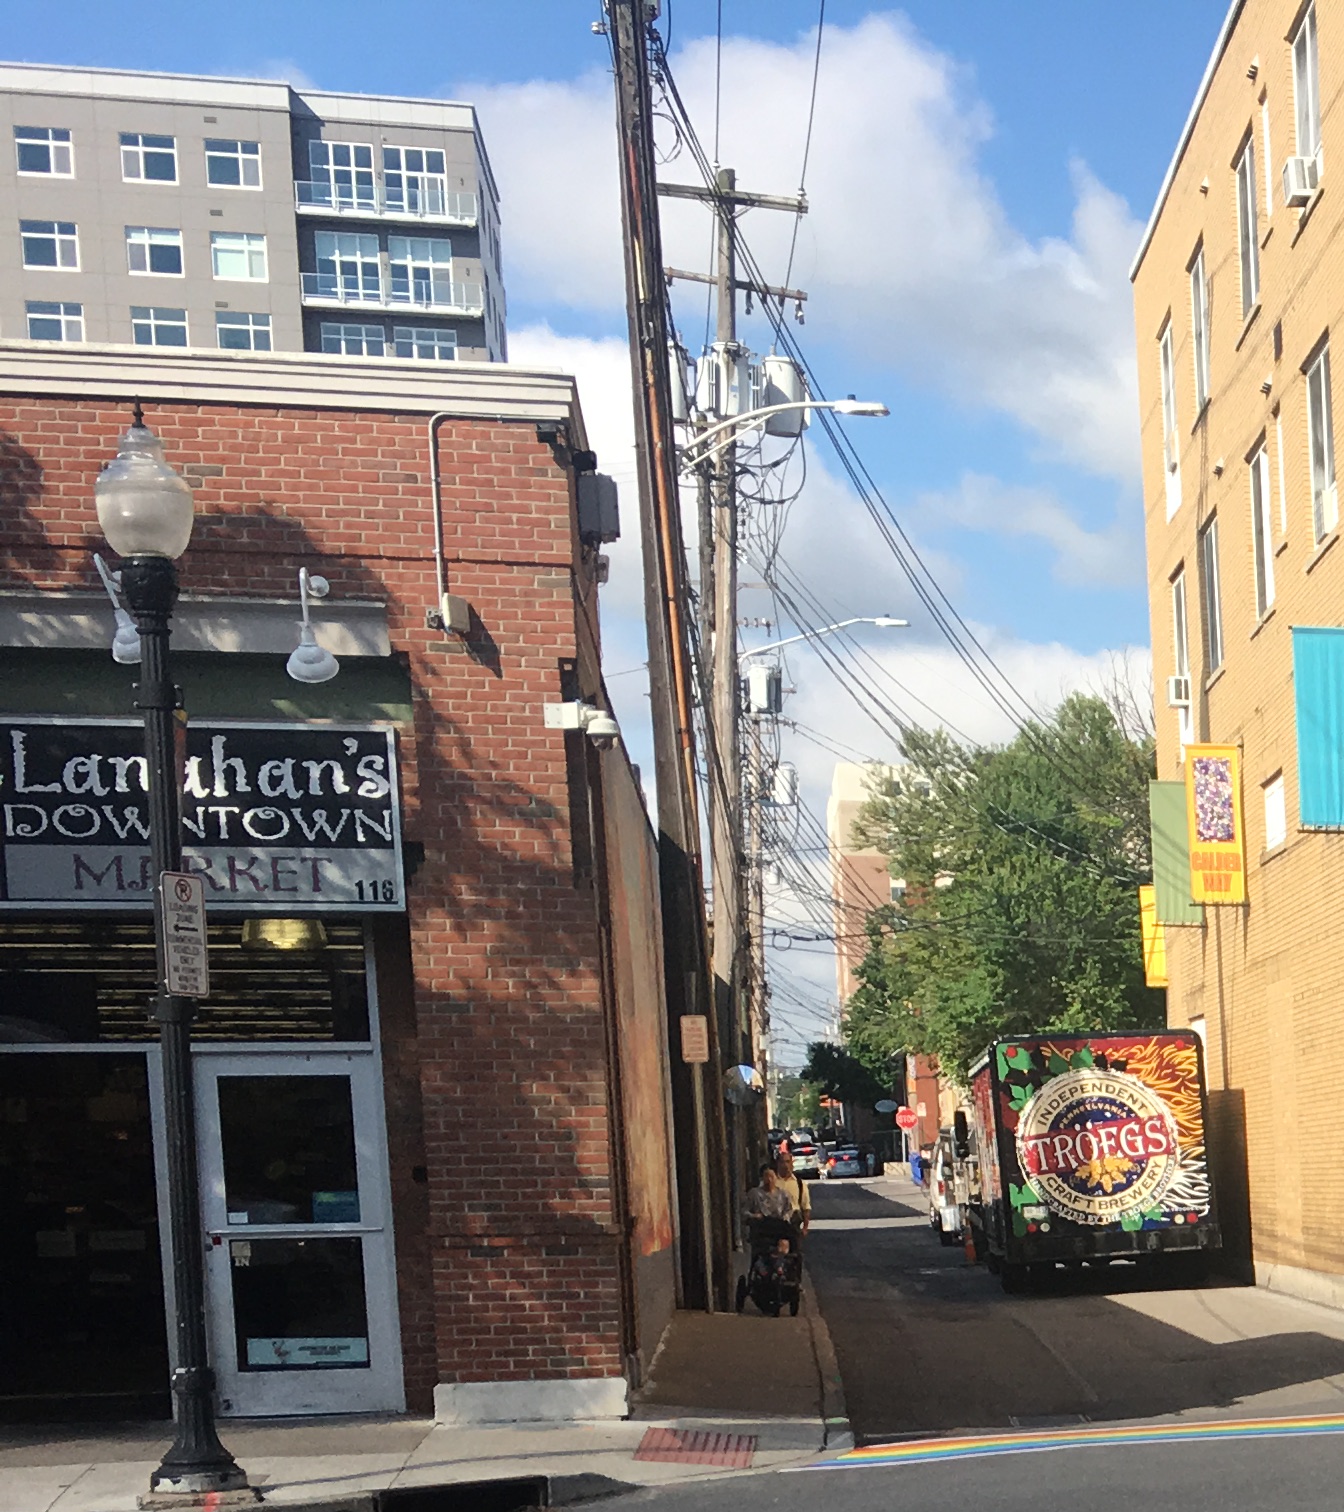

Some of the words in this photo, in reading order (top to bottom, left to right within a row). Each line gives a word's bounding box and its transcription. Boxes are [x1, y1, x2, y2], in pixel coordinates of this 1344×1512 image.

[4, 803, 392, 842] DOWNTOWN
[1192, 851, 1241, 872] CALDER
[355, 879, 395, 902] 116
[1202, 872, 1232, 892] WAY
[1037, 1083, 1149, 1127] INDEPENDENT
[1059, 1101, 1128, 1129] PENNSYLVANIA
[899, 1114, 917, 1124] STOP
[1045, 1176, 1095, 1209] CRAFT
[1098, 1159, 1162, 1211] BREWERY
